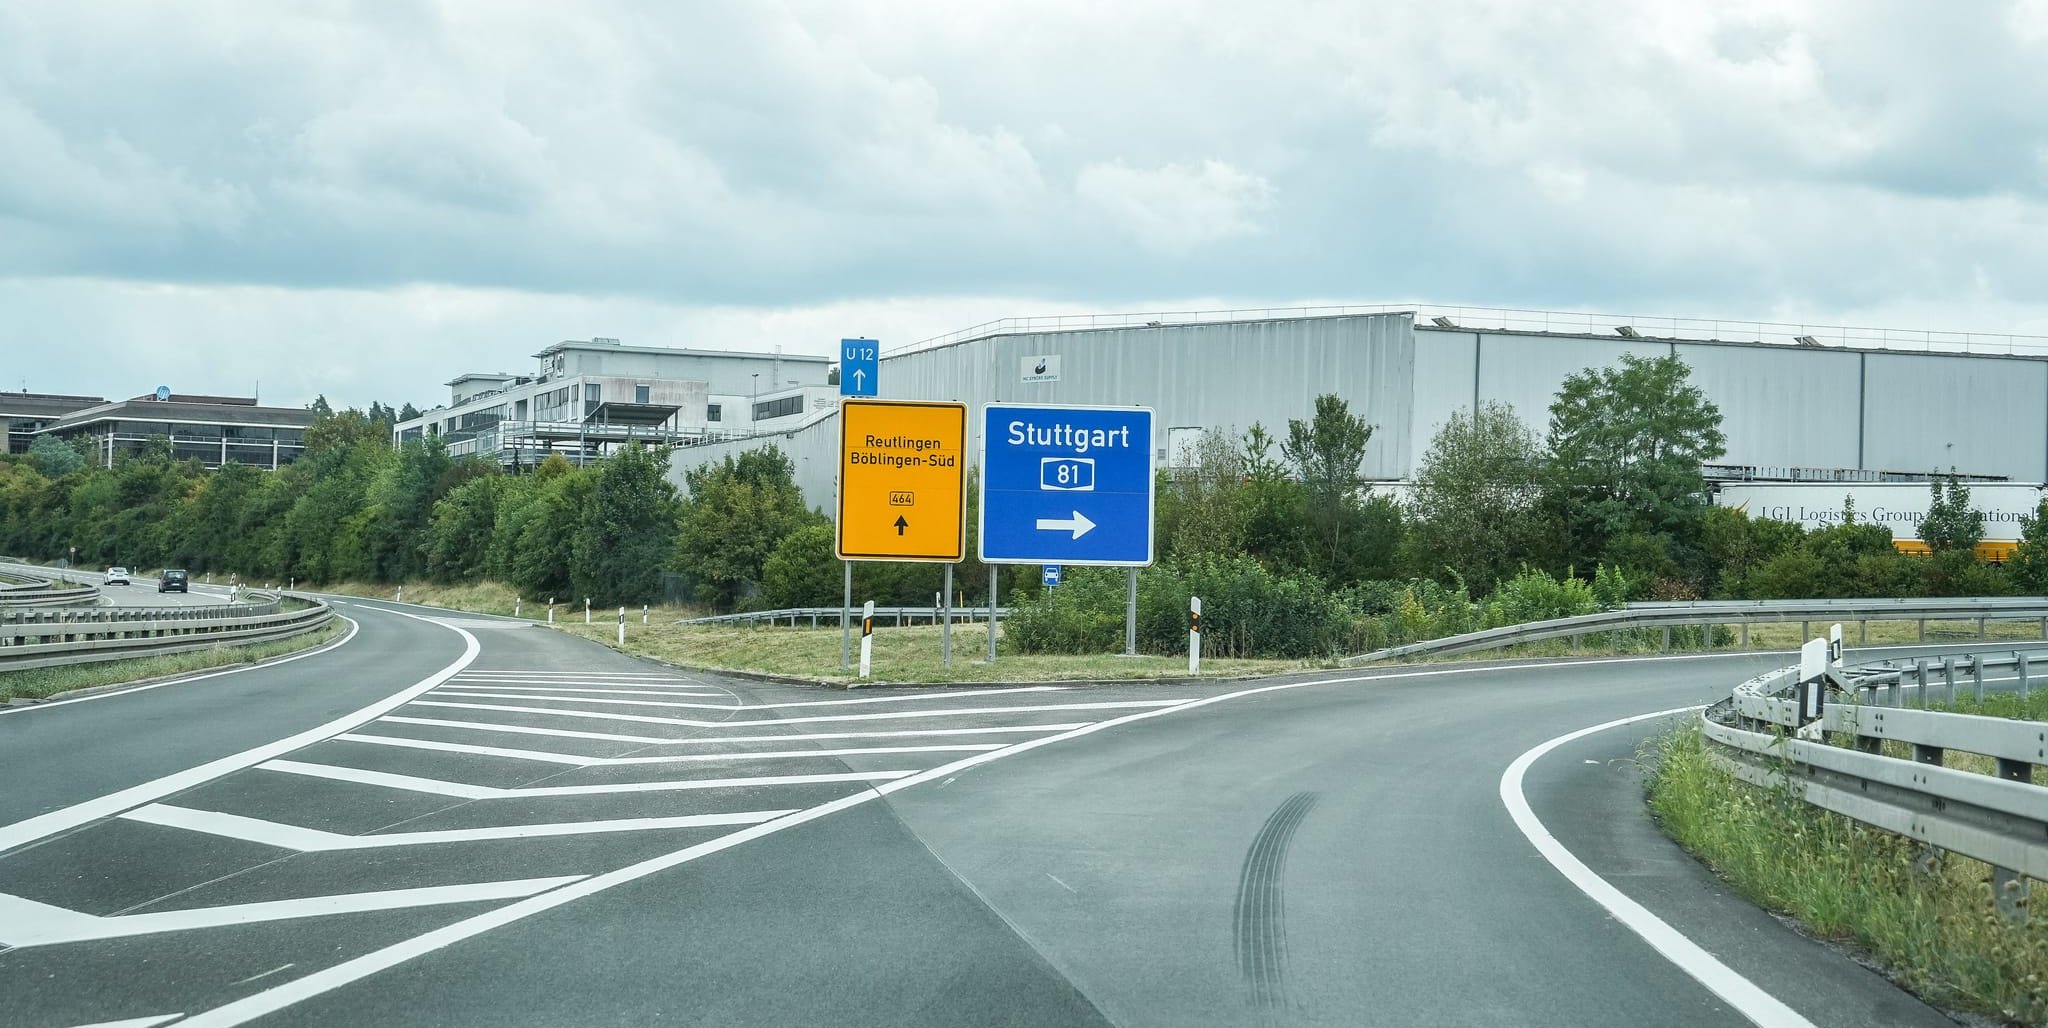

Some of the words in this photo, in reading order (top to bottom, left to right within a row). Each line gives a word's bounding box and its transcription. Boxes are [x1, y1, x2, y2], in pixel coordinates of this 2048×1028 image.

[846, 347, 856, 360] U
[860, 347, 874, 361] 12
[866, 435, 941, 451] Reutlingen
[1007, 421, 1129, 453] Stuttgart
[851, 452, 955, 468] Böblingen-Süd
[1057, 464, 1078, 484] 81
[892, 494, 912, 504] 464
[1800, 506, 1867, 527] Logistcs
[1872, 506, 1923, 527] Group
